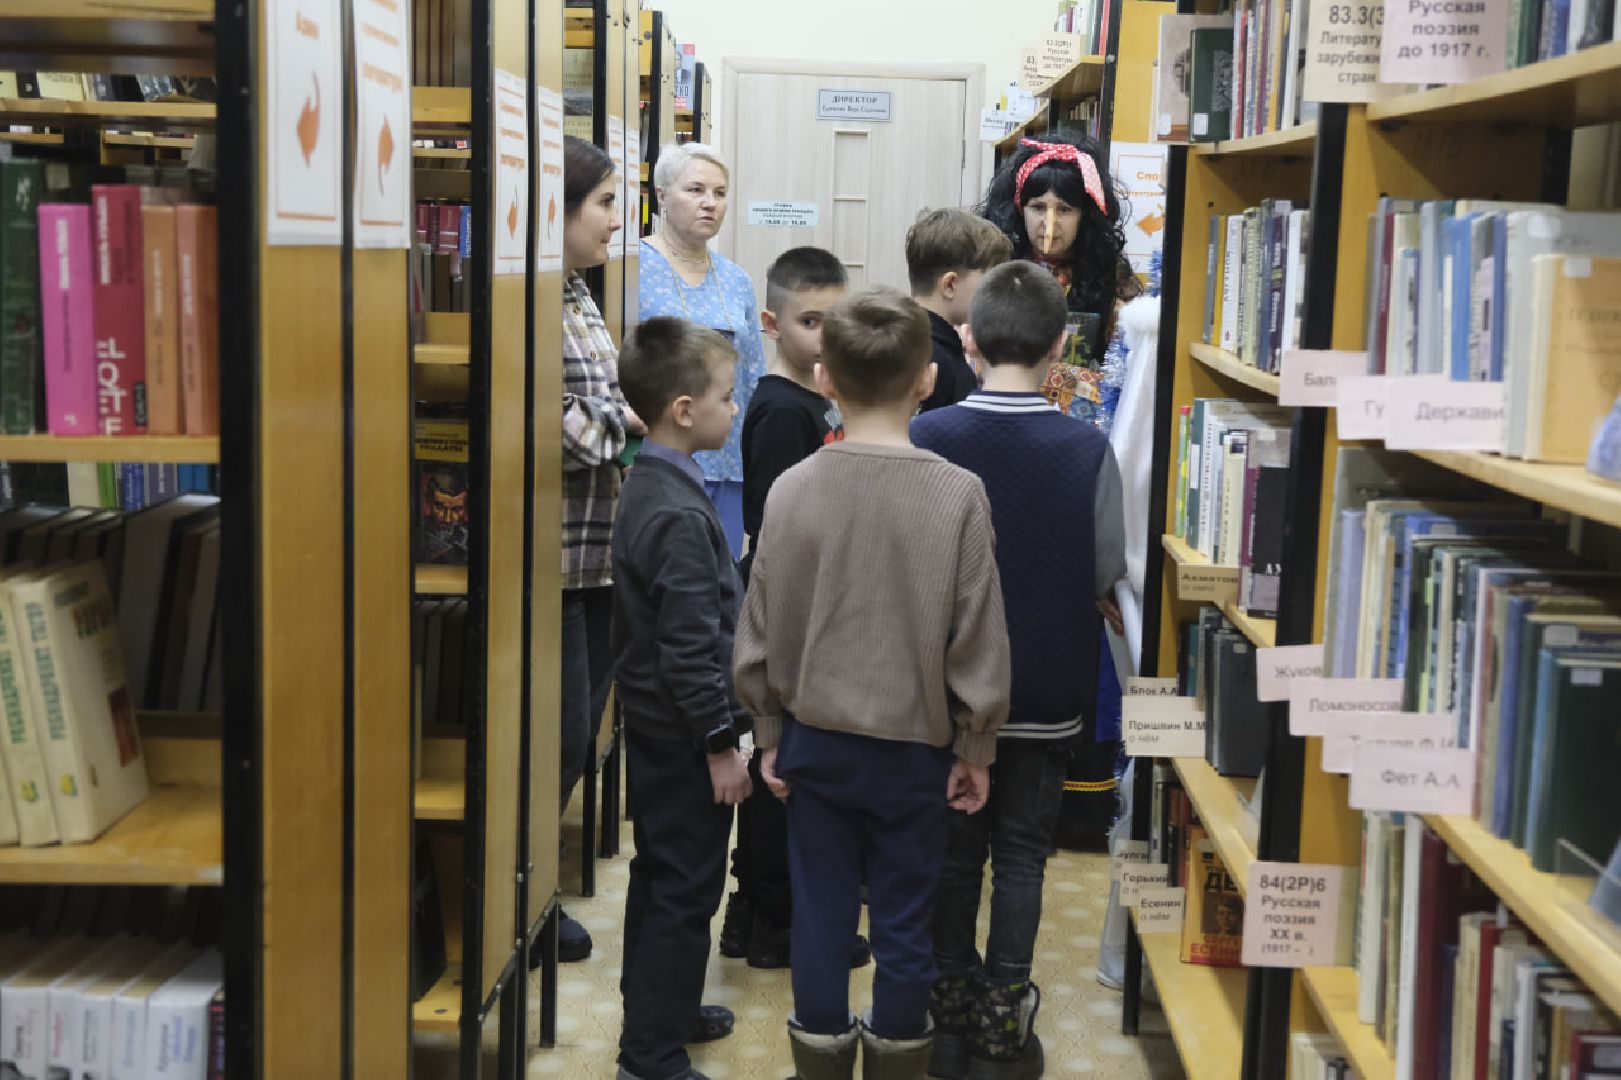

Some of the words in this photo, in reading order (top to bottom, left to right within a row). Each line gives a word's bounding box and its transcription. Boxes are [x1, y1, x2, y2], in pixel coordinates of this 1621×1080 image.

[1409, 0, 1486, 17] Русская
[1412, 23, 1480, 36] поэзия
[1398, 45, 1423, 59] до
[1431, 43, 1471, 57] 1917
[1337, 71, 1376, 84] стран
[832, 95, 878, 104] ДИРЕКТОР
[1129, 685, 1157, 696] Блок
[1128, 720, 1181, 731] Пришвин
[1380, 769, 1418, 785] Фет
[1259, 874, 1326, 894] 84(2Р)6
[1140, 899, 1181, 909] Есенин
[1261, 895, 1321, 910] Русская
[1264, 914, 1316, 925] поэзия
